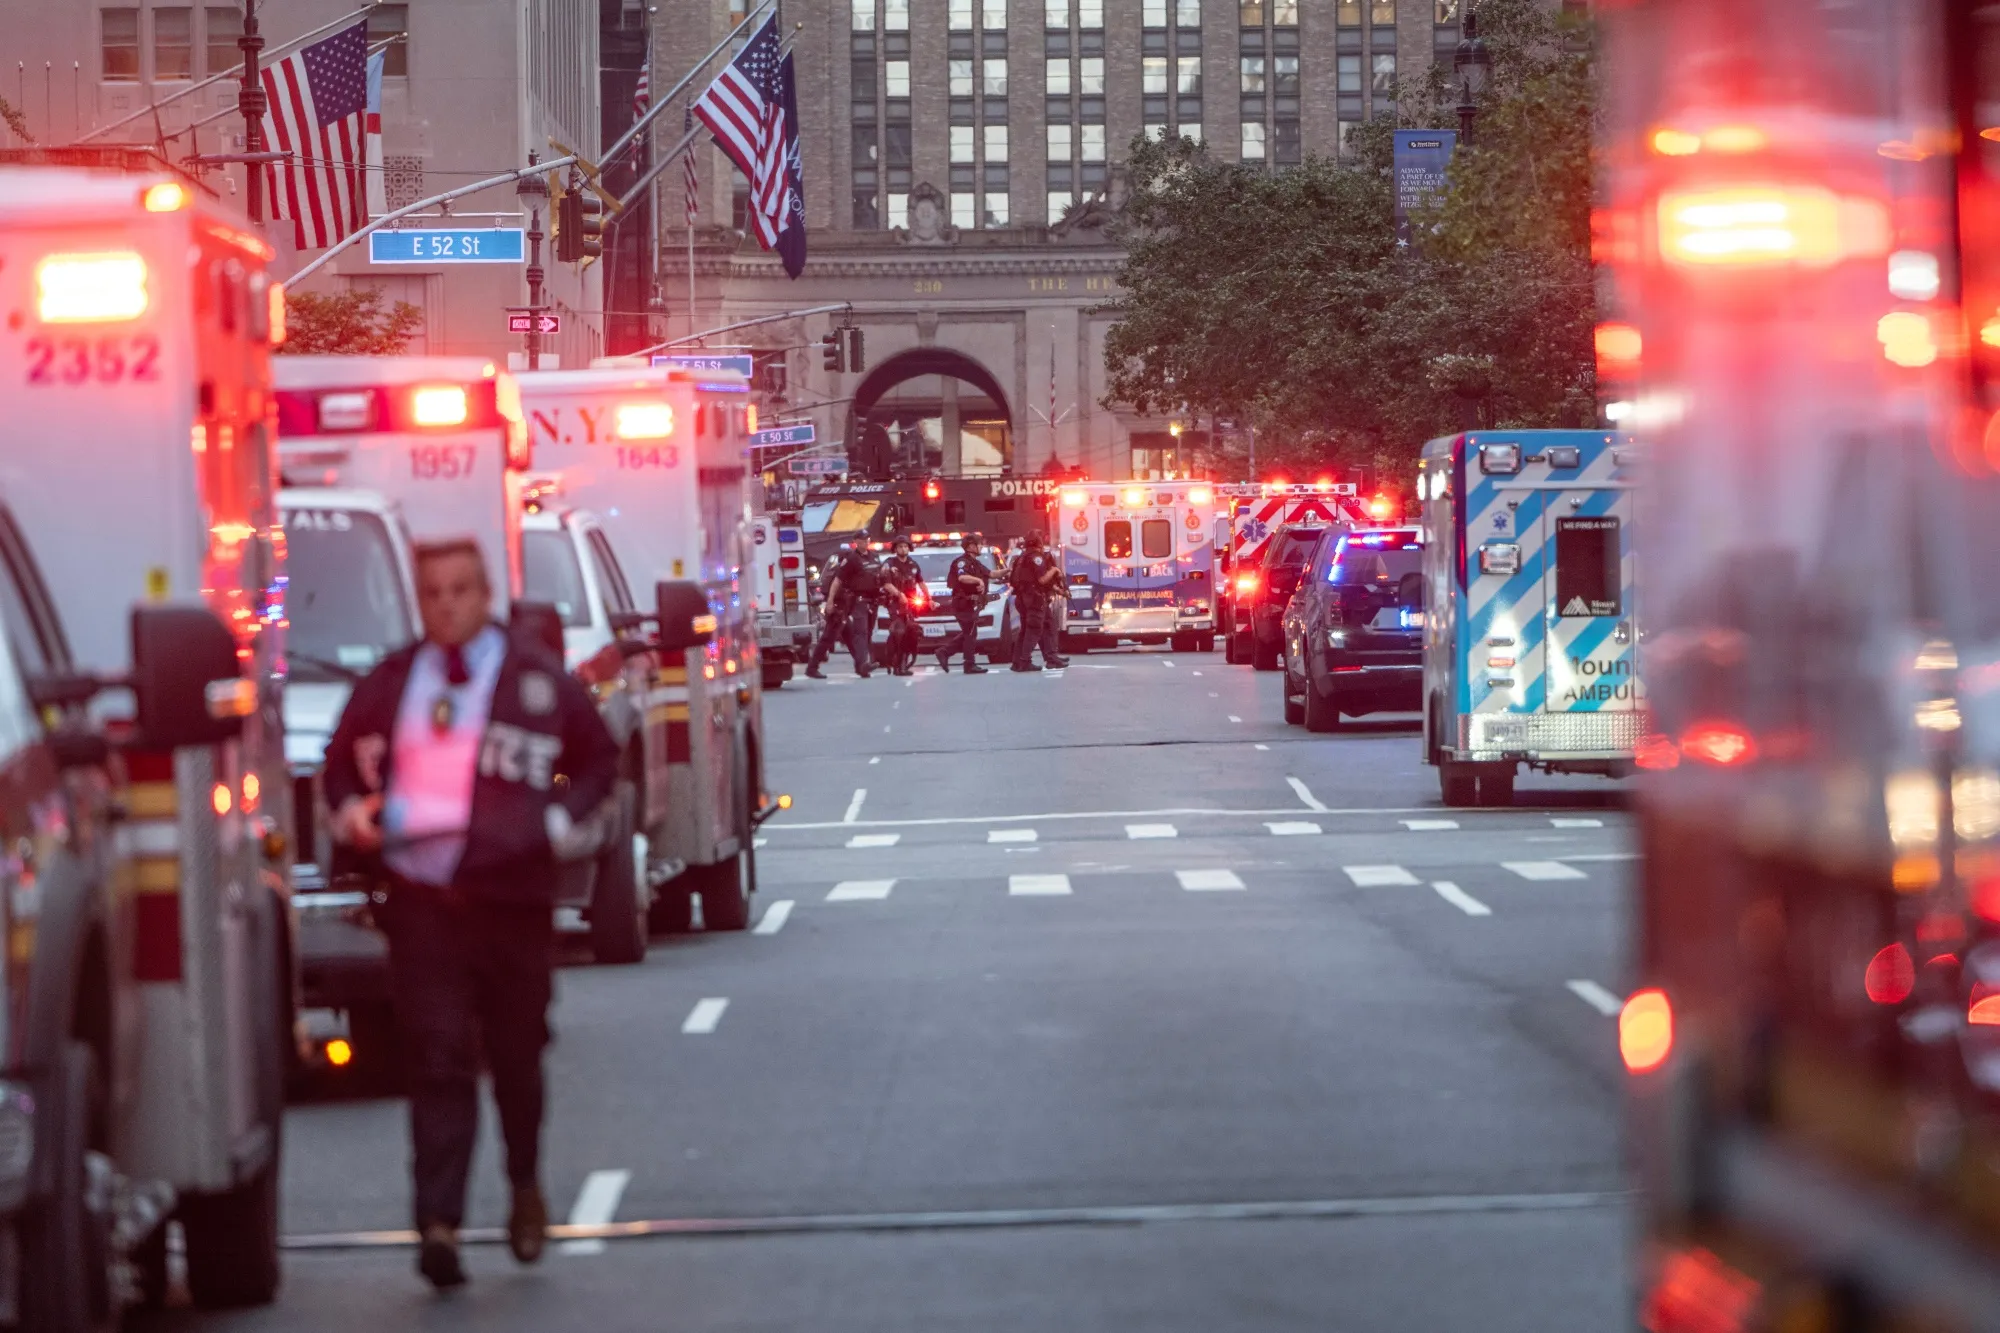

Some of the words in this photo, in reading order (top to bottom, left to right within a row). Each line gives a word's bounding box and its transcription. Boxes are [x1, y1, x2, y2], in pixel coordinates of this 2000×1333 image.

[413, 237, 424, 255] E
[431, 237, 454, 255] 52
[461, 236, 480, 255] St
[913, 281, 942, 293] 230
[1028, 277, 1067, 291] THE
[26, 336, 162, 388] 2352
[694, 360, 706, 370] 51
[710, 360, 722, 370] St
[761, 433, 767, 442] E
[770, 432, 782, 442] 50
[784, 431, 793, 441] St
[410, 446, 477, 480] 1957
[616, 446, 680, 469] 1643
[818, 486, 841, 494] NYPD
[850, 485, 884, 493] POLICE
[990, 480, 1055, 497] POLICE
[1103, 568, 1127, 578] KEEP
[1150, 566, 1174, 577] BACK
[1104, 591, 1136, 600] HATZALAH
[1137, 590, 1174, 599] AMBULANCE
